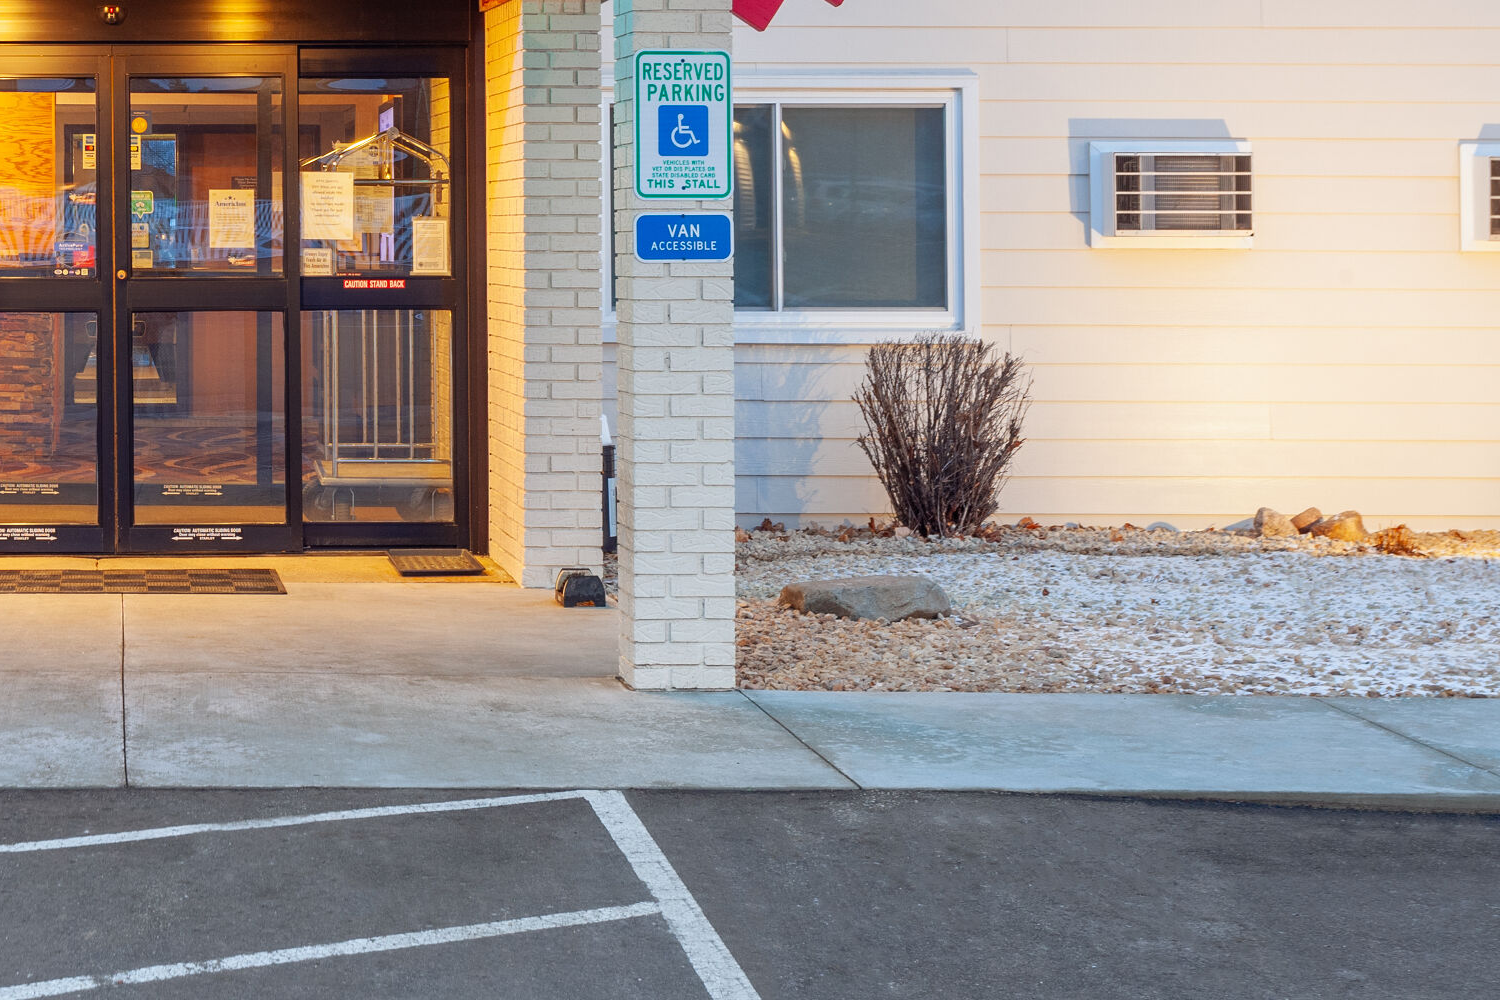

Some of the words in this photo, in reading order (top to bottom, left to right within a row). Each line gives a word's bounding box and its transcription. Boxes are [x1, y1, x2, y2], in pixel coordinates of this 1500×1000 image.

[642, 62, 724, 80] RESERVED
[648, 84, 724, 102] PARKING
[647, 179, 675, 188] THIS
[685, 179, 721, 188] STALL
[667, 224, 700, 238] VAN
[651, 241, 717, 251] ACCESSIBLE
[344, 280, 368, 288] CAUTION
[370, 280, 388, 288] STAND
[390, 280, 404, 288] BACK
